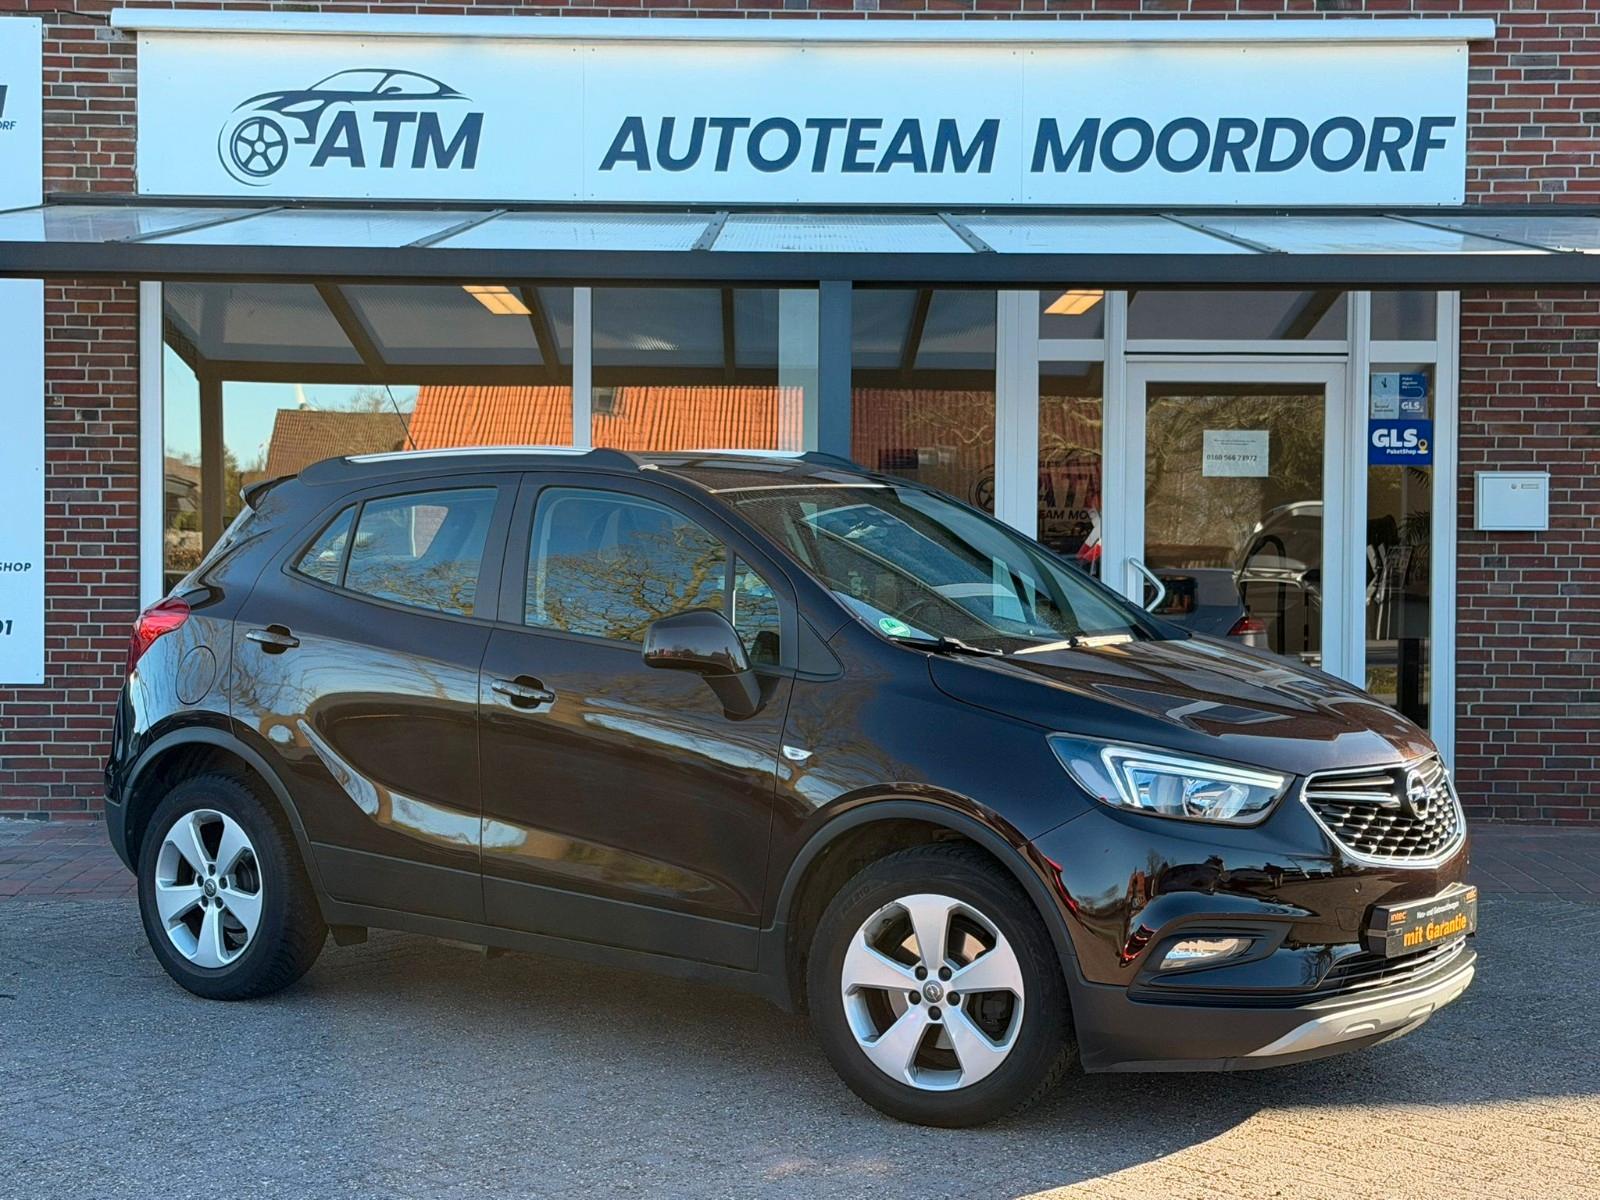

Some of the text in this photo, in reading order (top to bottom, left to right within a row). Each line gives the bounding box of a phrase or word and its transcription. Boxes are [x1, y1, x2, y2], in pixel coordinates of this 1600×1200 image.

[310, 111, 484, 169] ATM
[599, 116, 1456, 173] AUTOTEAM MOORDORF
[1401, 401, 1420, 410] GLS
[1372, 428, 1418, 448] GLS
[1403, 913, 1467, 947] mit Garantie
